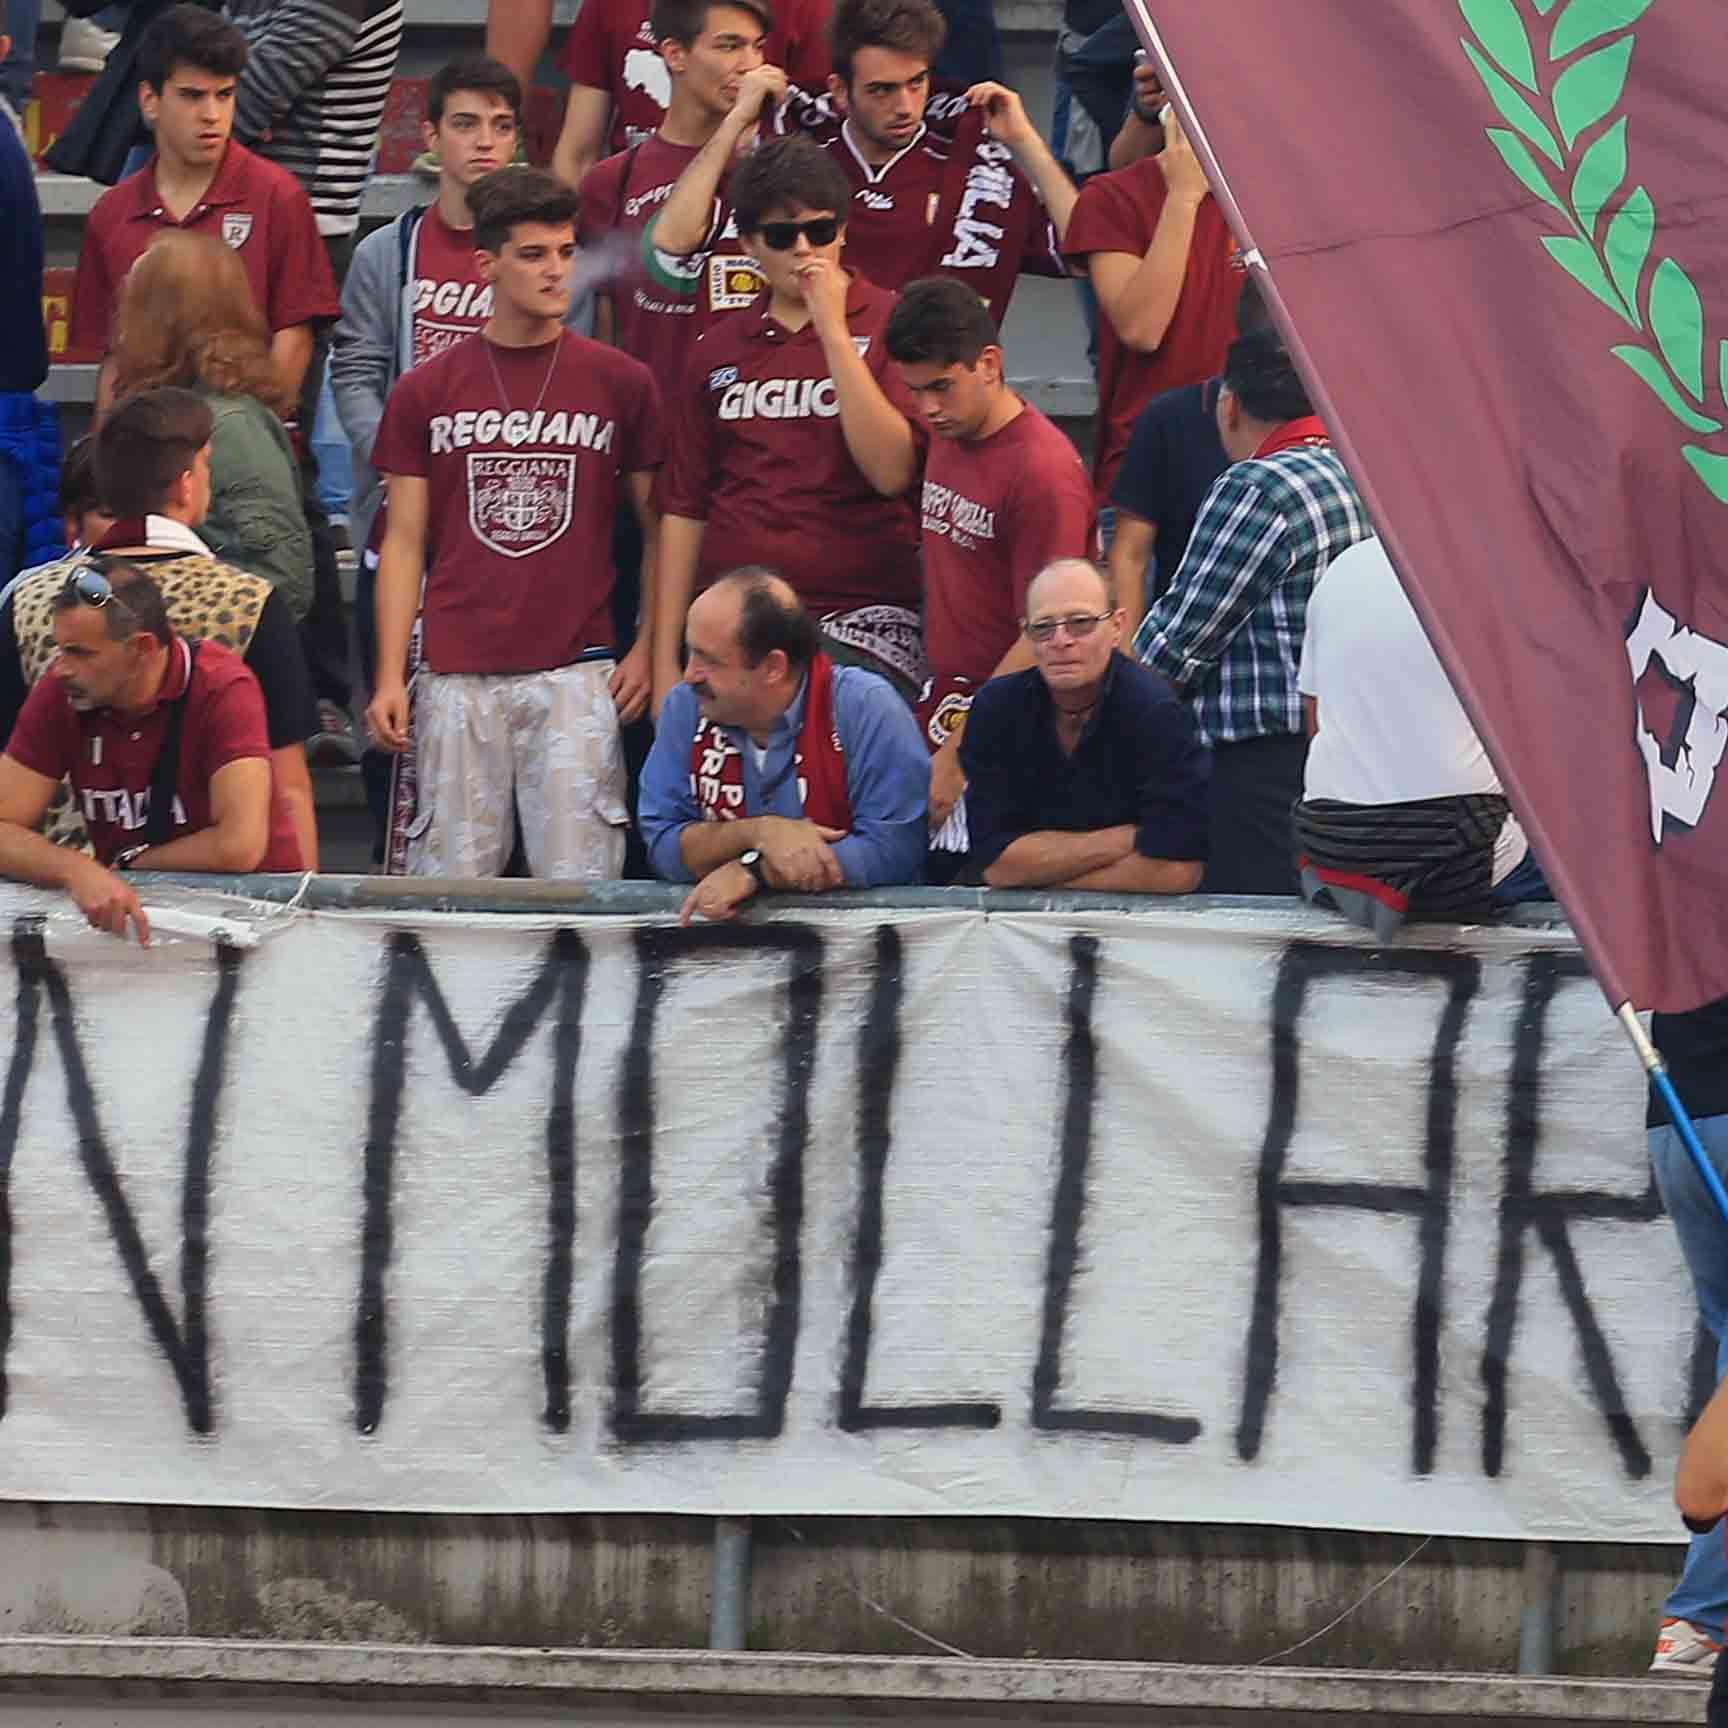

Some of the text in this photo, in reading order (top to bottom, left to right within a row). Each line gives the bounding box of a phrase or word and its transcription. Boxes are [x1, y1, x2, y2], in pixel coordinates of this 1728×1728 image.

[429, 408, 616, 455] REGGIANA
[473, 459, 568, 477] REGGIANA
[80, 784, 188, 831] ITALA
